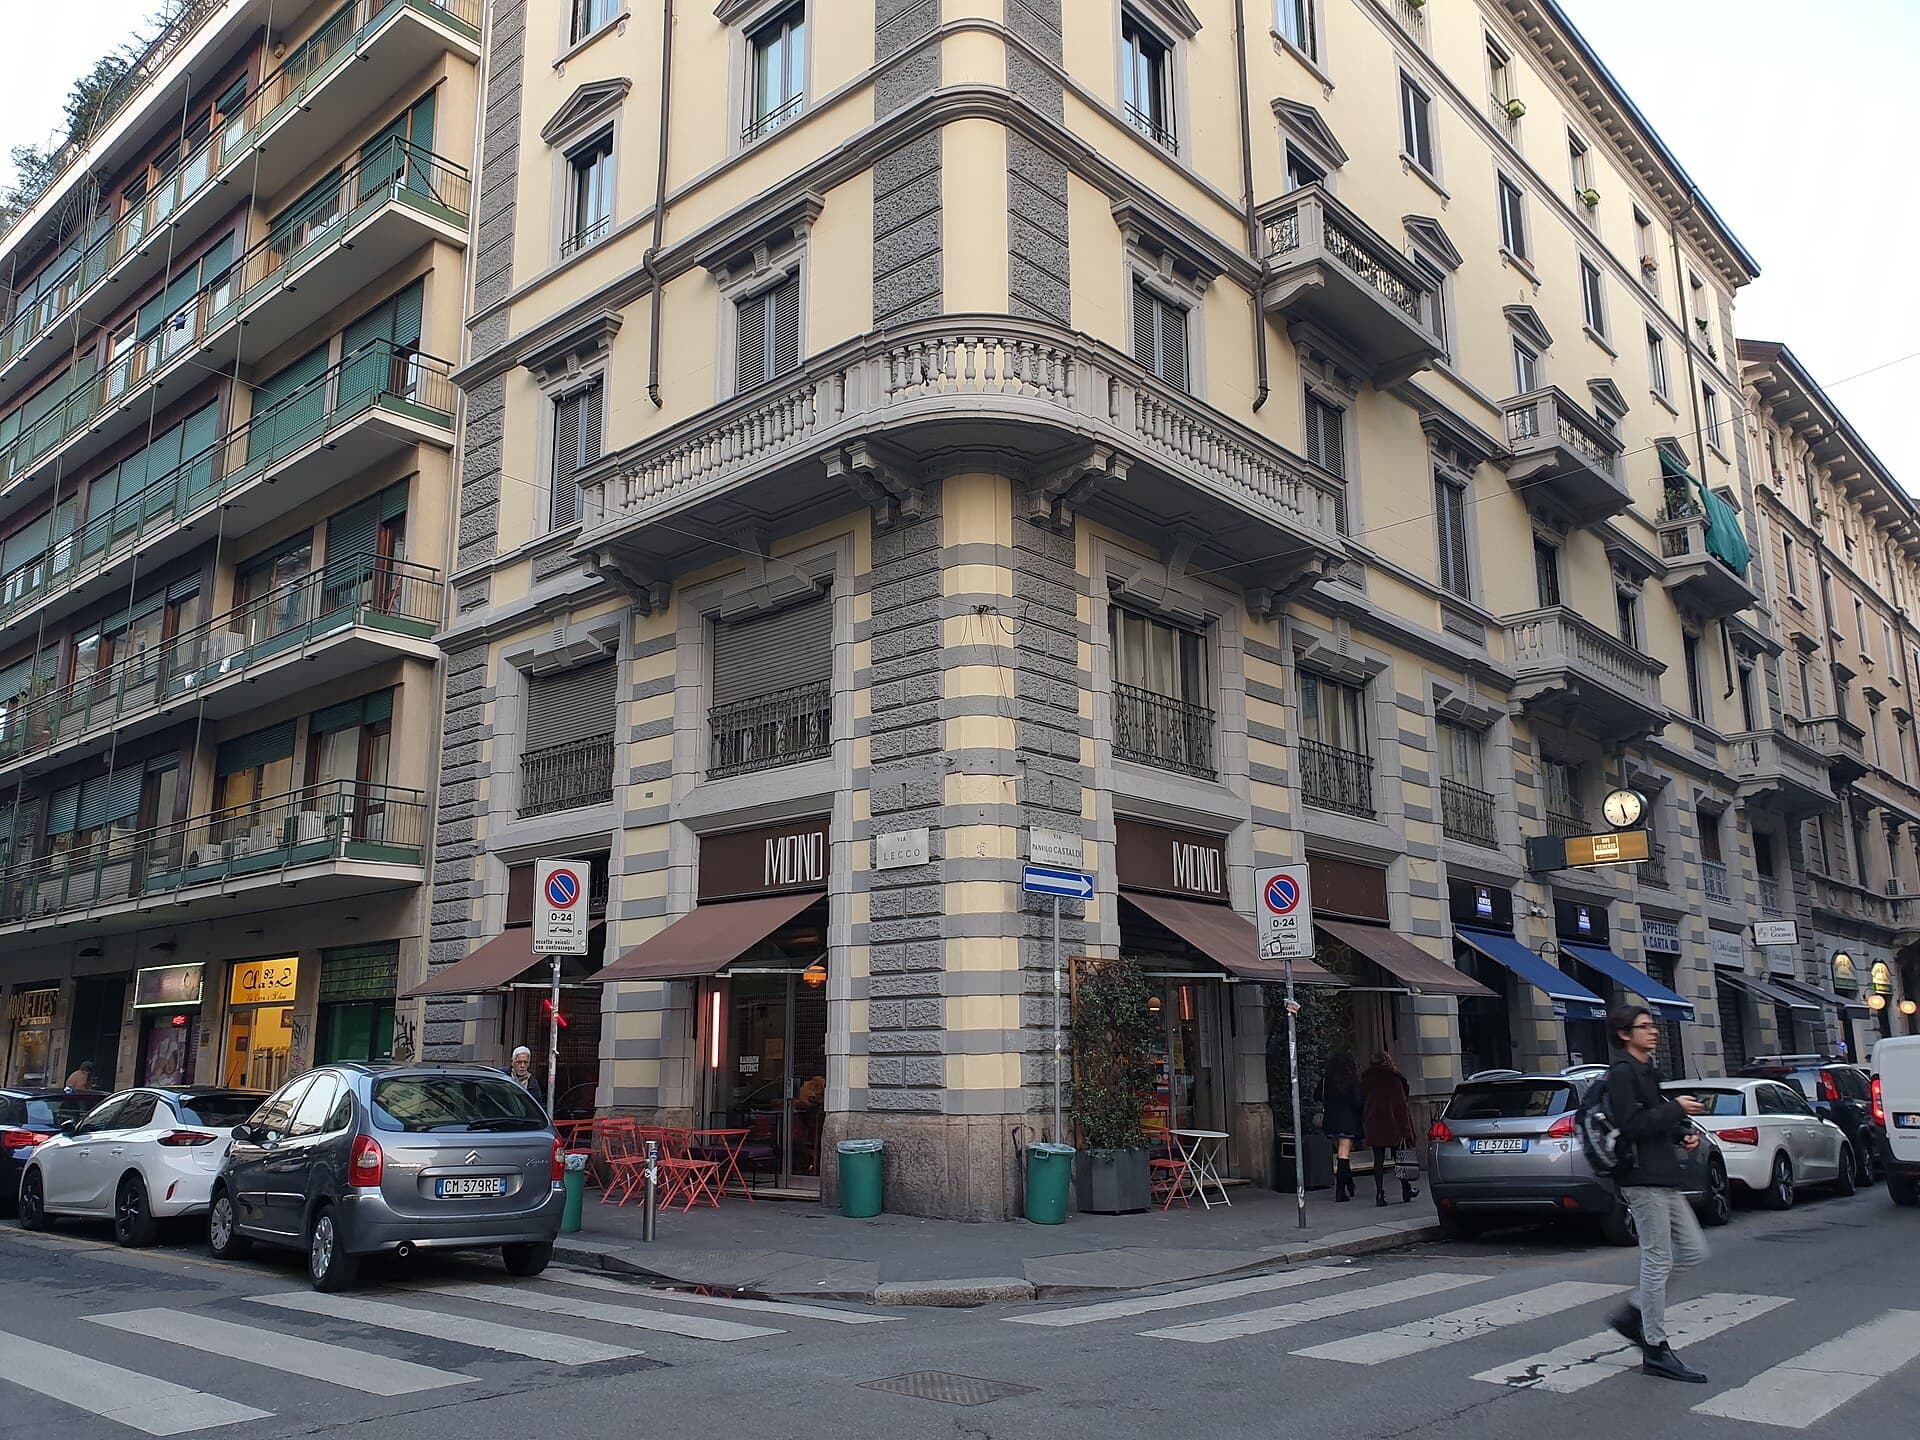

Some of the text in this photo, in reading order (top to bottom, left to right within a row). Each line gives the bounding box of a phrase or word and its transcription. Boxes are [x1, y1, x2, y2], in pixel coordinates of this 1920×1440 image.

[883, 848, 921, 861] LECCO
[1053, 846, 1082, 858] CASTALDI
[764, 832, 823, 886] MONO
[1172, 840, 1221, 893] MONO
[551, 912, 572, 921] 0-24
[1272, 918, 1295, 928] 0-24
[1650, 936, 1670, 951] CARTA
[1476, 1140, 1489, 1150] EY
[444, 1178, 499, 1193] CM 379RE
